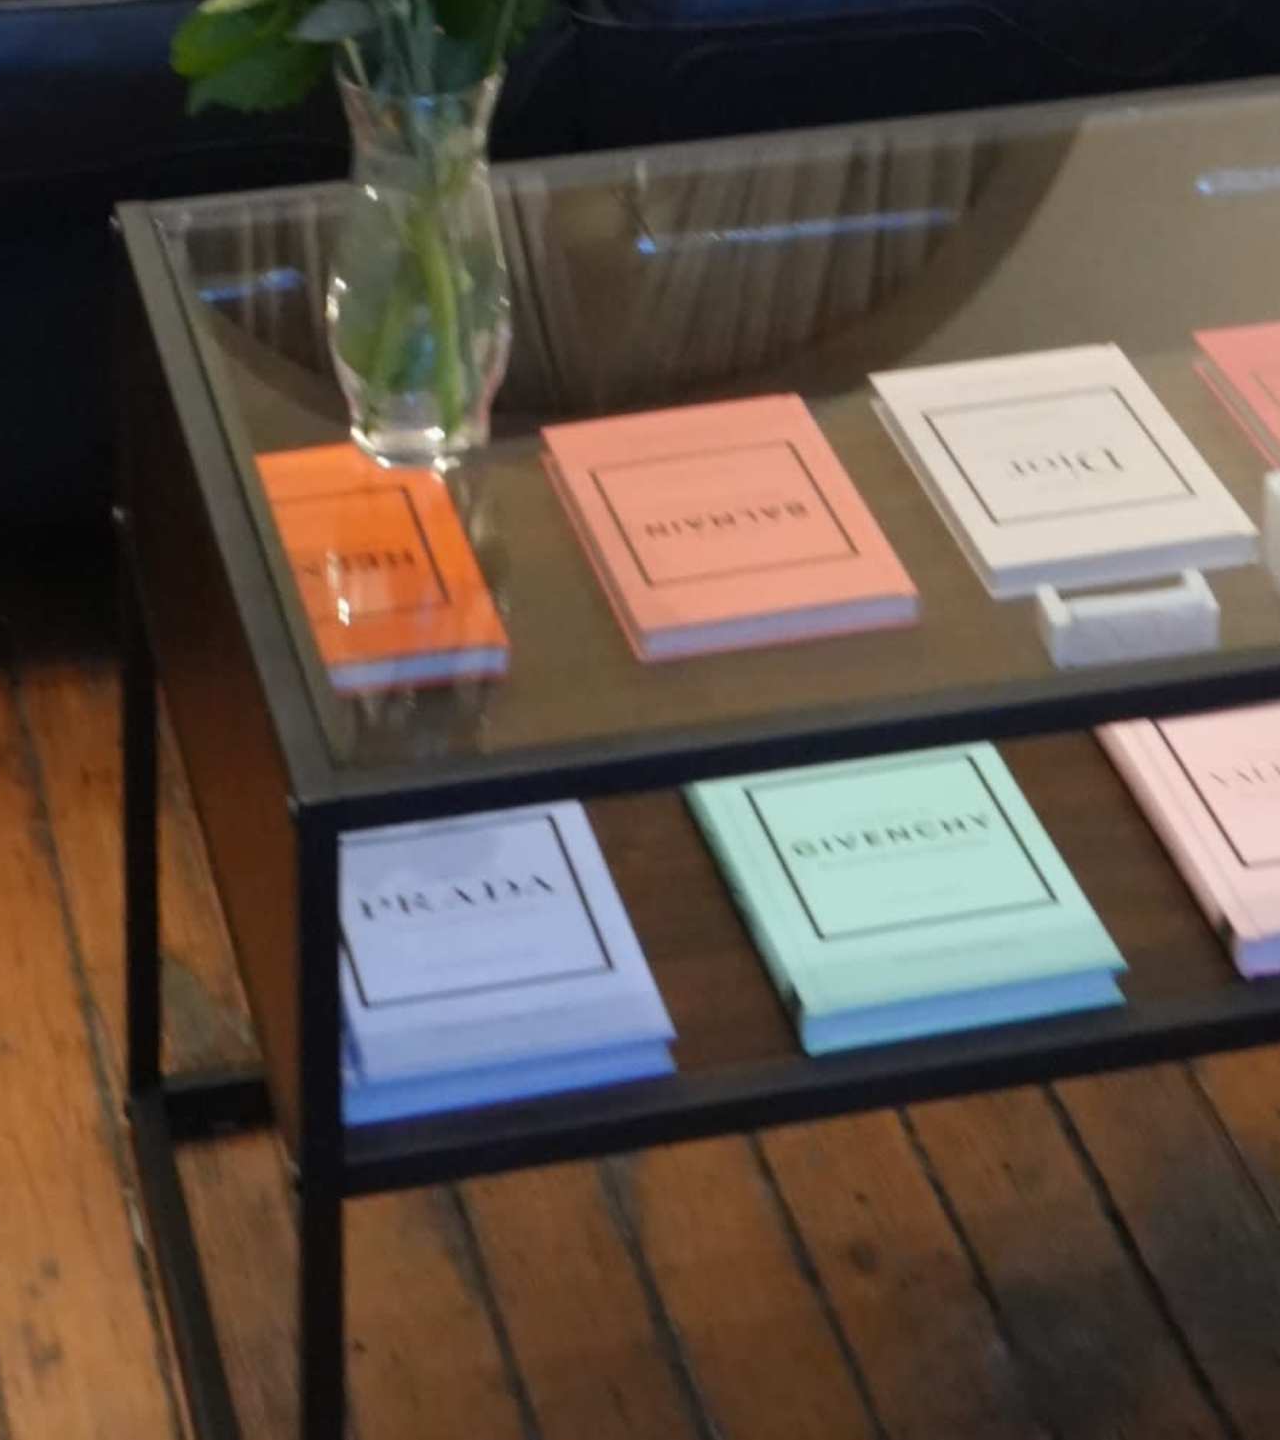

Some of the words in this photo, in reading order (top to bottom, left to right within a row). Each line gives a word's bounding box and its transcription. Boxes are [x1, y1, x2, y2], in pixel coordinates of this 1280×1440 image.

[1006, 447, 1125, 480] Dior
[643, 501, 809, 538] BALMAIN
[788, 813, 994, 858] GIVENCHY
[358, 874, 555, 921] PRADA
